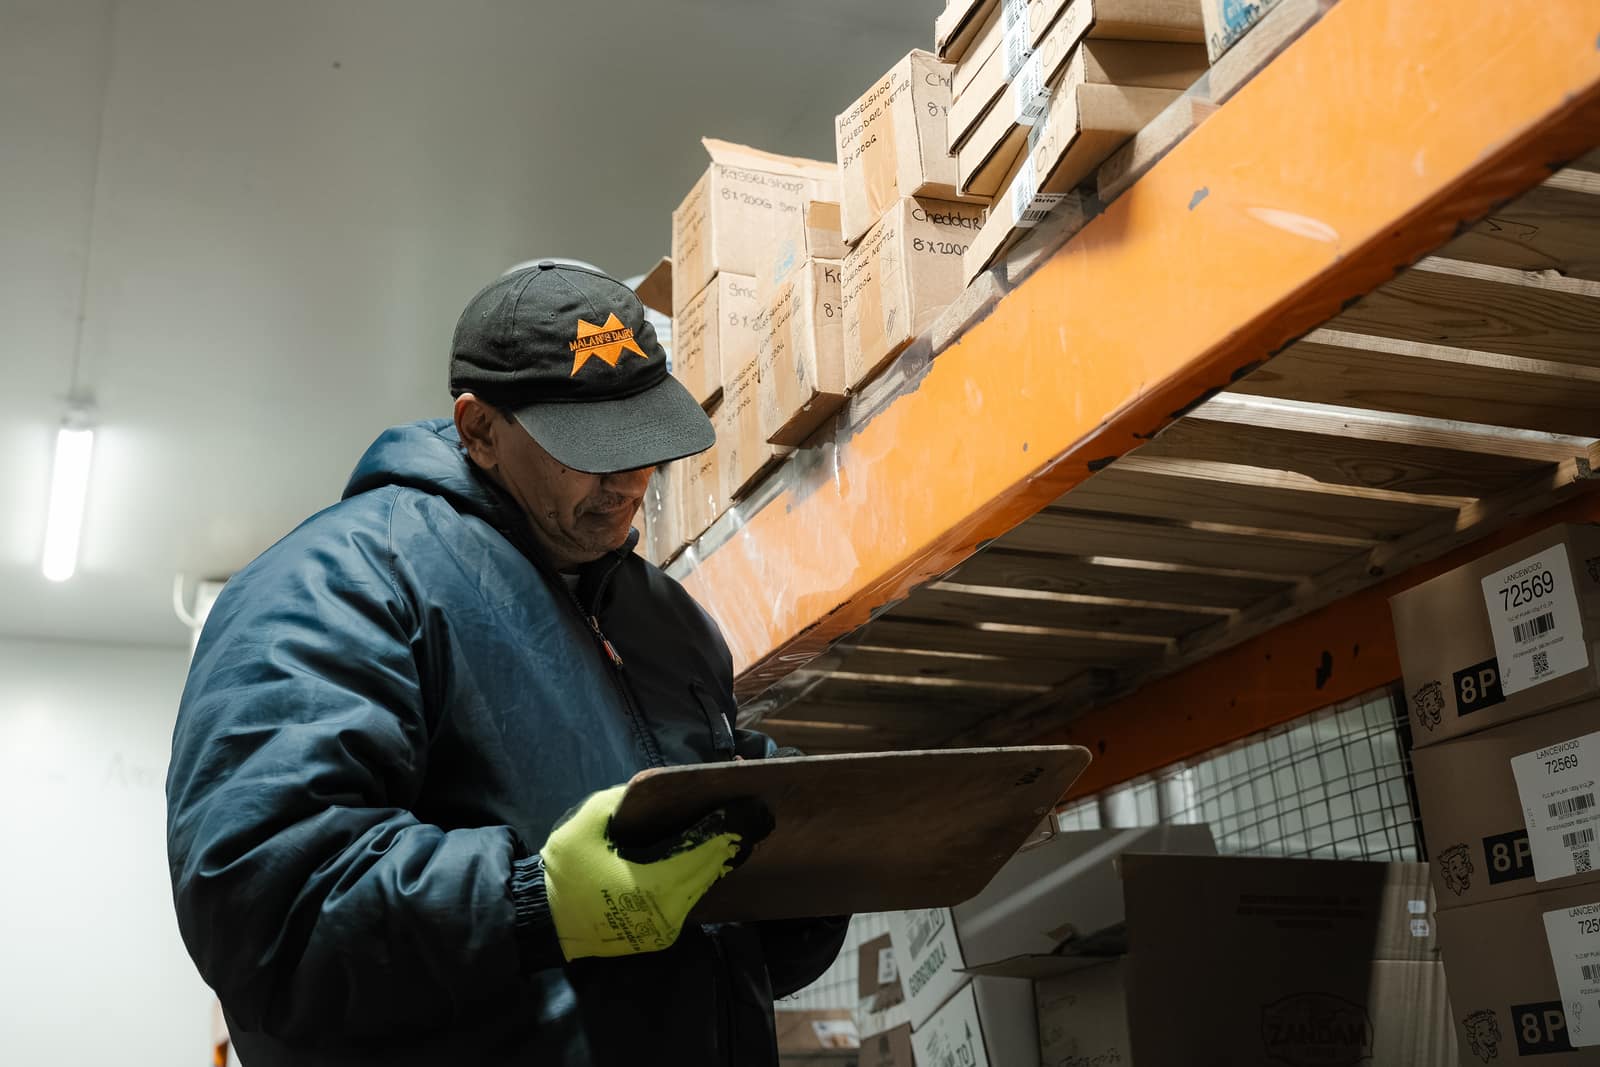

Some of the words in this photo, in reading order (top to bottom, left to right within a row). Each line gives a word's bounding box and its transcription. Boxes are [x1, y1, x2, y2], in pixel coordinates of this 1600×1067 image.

[569, 334, 612, 352] MALAN'S
[612, 327, 635, 342] DAIRY
[1503, 561, 1543, 584] LANCEWOOD
[1498, 570, 1555, 612] 72569
[1536, 739, 1581, 760] LANCEWOOD
[1544, 753, 1579, 776] 72569
[1577, 918, 1600, 936] 725
